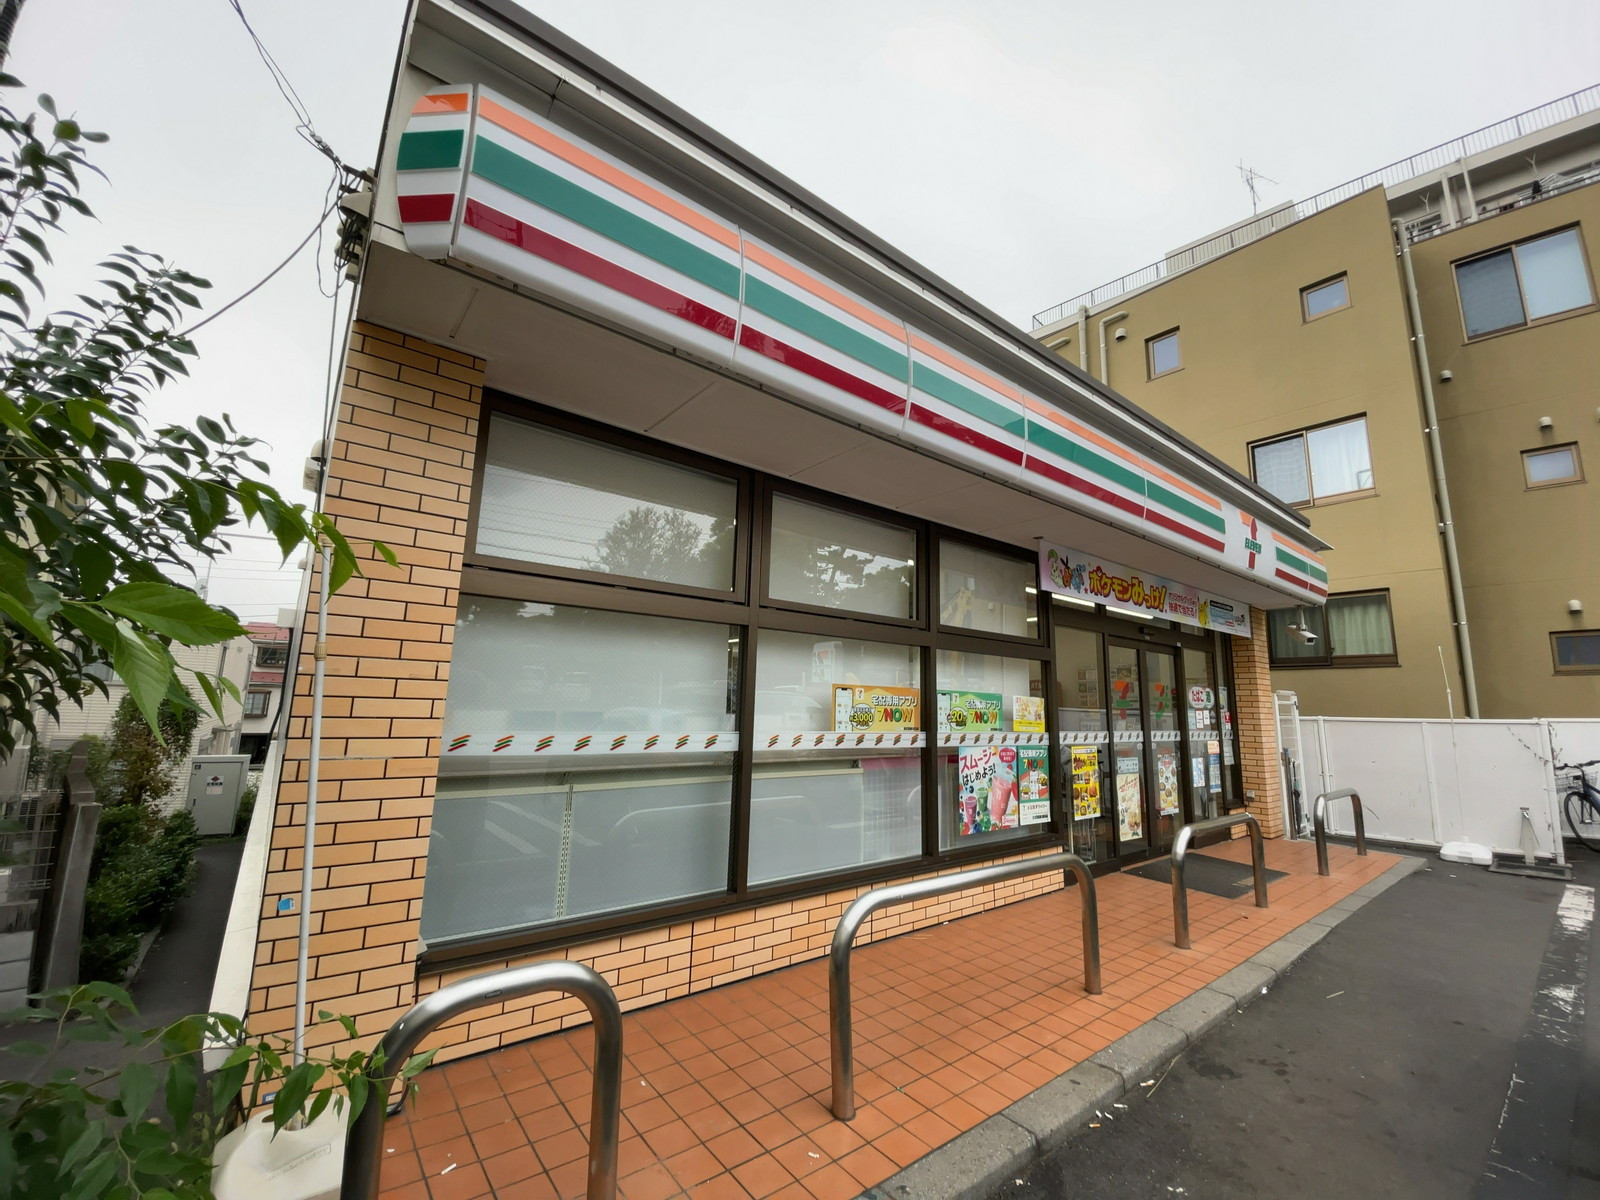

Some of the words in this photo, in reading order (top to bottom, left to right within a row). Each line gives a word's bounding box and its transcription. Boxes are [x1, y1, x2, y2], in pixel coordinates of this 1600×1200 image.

[871, 694, 918, 707] 宅配専用アプリ
[877, 707, 914, 723] 7NOW
[968, 710, 998, 724] 7NOW
[960, 746, 997, 773] スムージー
[1022, 758, 1045, 770] 7NOW
[962, 763, 997, 788] はじめよう!
